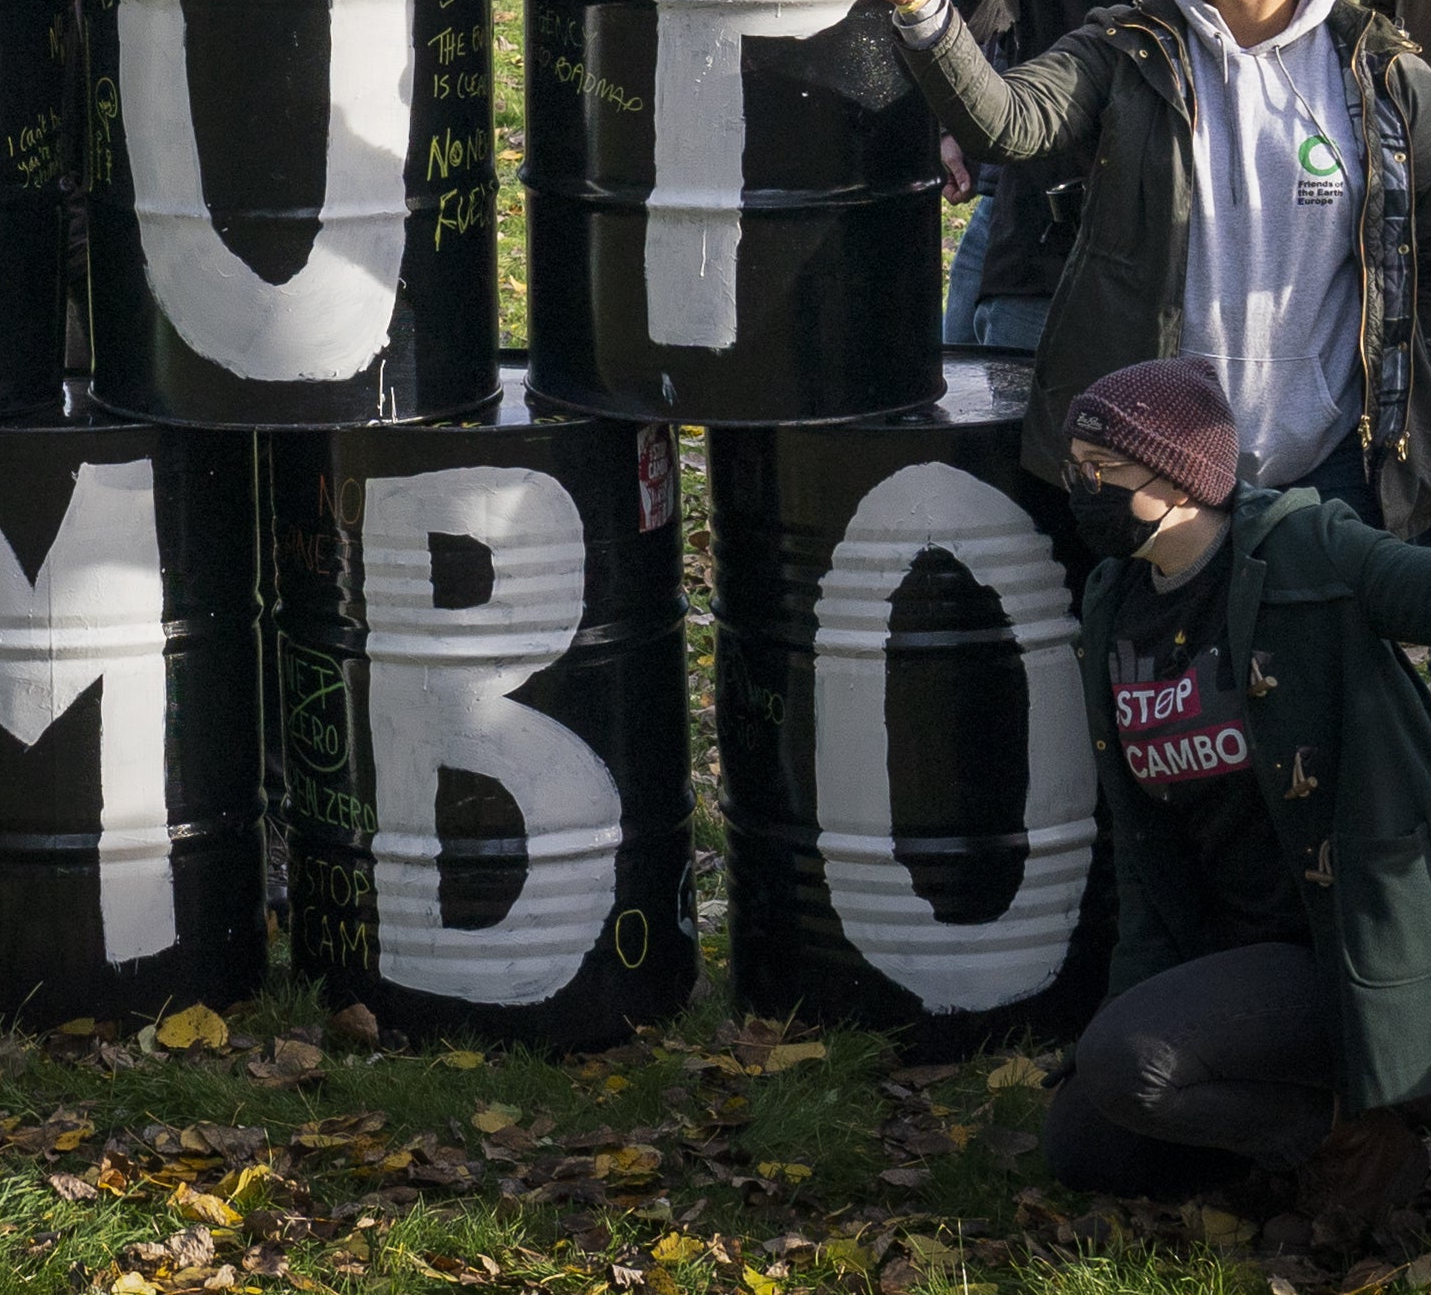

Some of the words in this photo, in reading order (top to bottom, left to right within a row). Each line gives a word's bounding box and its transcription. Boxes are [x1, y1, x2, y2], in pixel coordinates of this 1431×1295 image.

[427, 27, 467, 66] THE
[433, 74, 450, 99] IS
[1298, 180, 1334, 189] Friends
[1335, 180, 1344, 188] of
[1298, 189, 1315, 197] the
[1317, 188, 1344, 198] Earth
[1297, 198, 1334, 207] Europe
[1115, 677, 1194, 729] STOP
[1146, 728, 1249, 780] CAMBO
